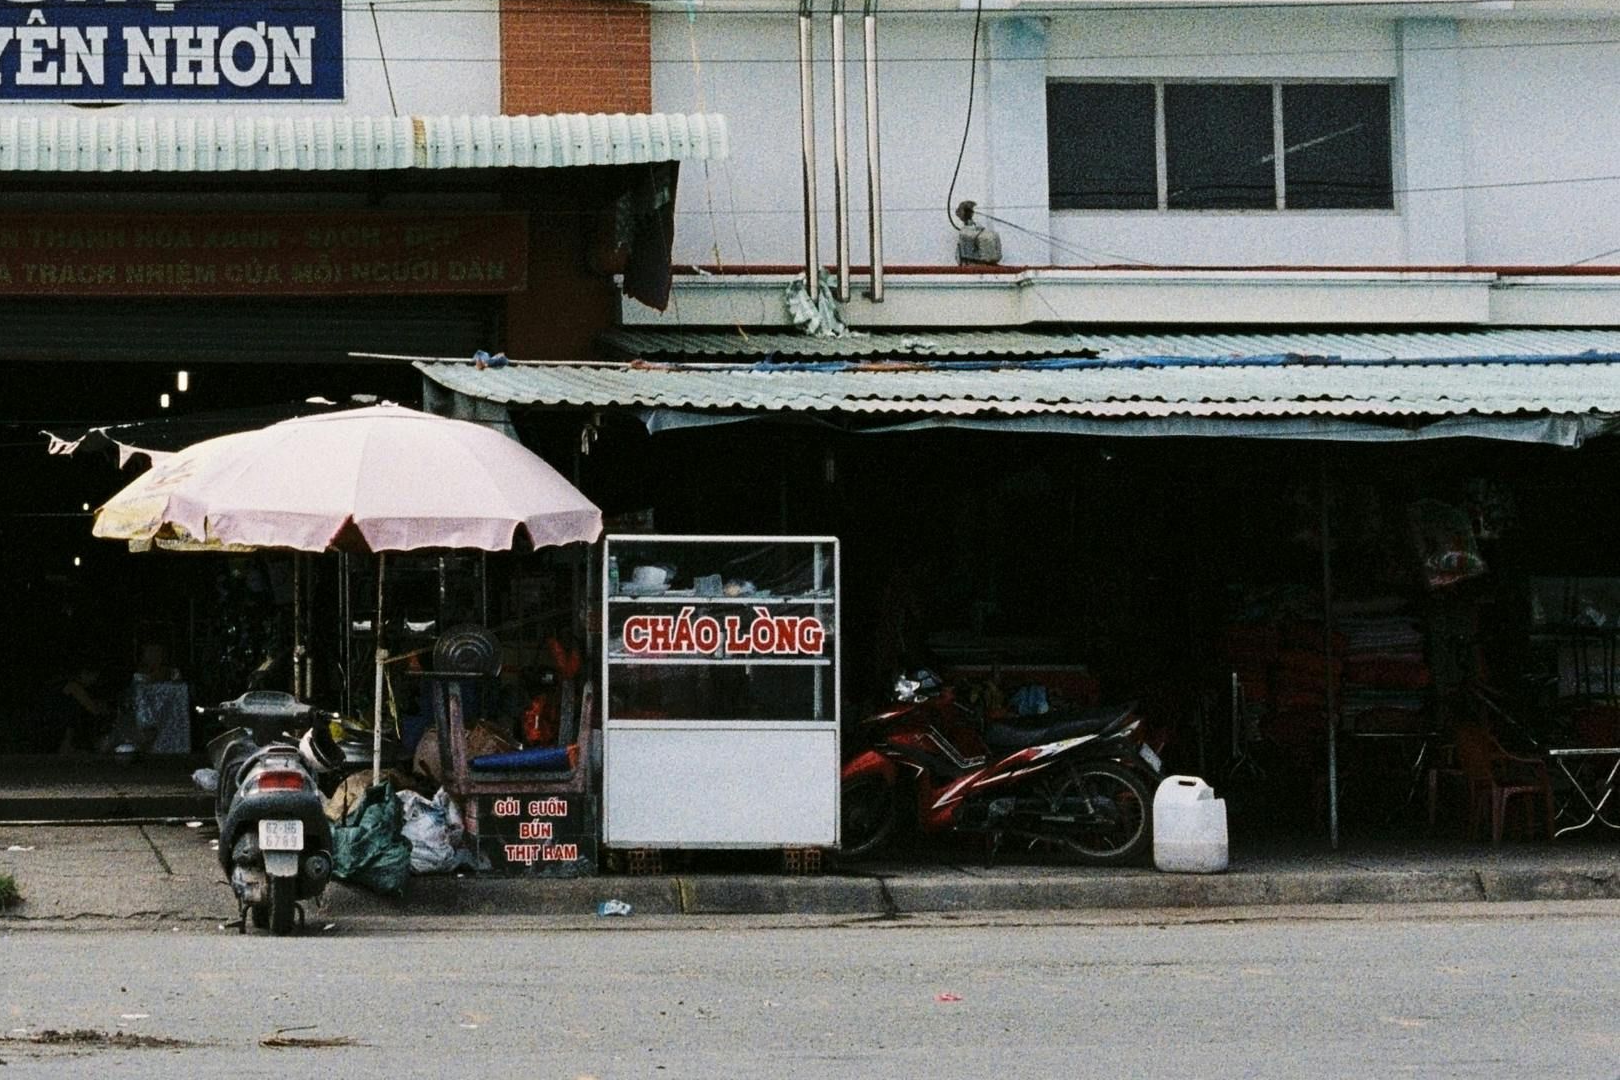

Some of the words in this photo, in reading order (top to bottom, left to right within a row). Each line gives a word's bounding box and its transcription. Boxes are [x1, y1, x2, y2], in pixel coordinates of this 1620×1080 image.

[123, 21, 315, 88] NHƠN
[623, 606, 722, 654] CHÁO
[725, 606, 825, 655] LÒNG
[505, 844, 540, 866] THỊT
[542, 843, 578, 861] RAM
